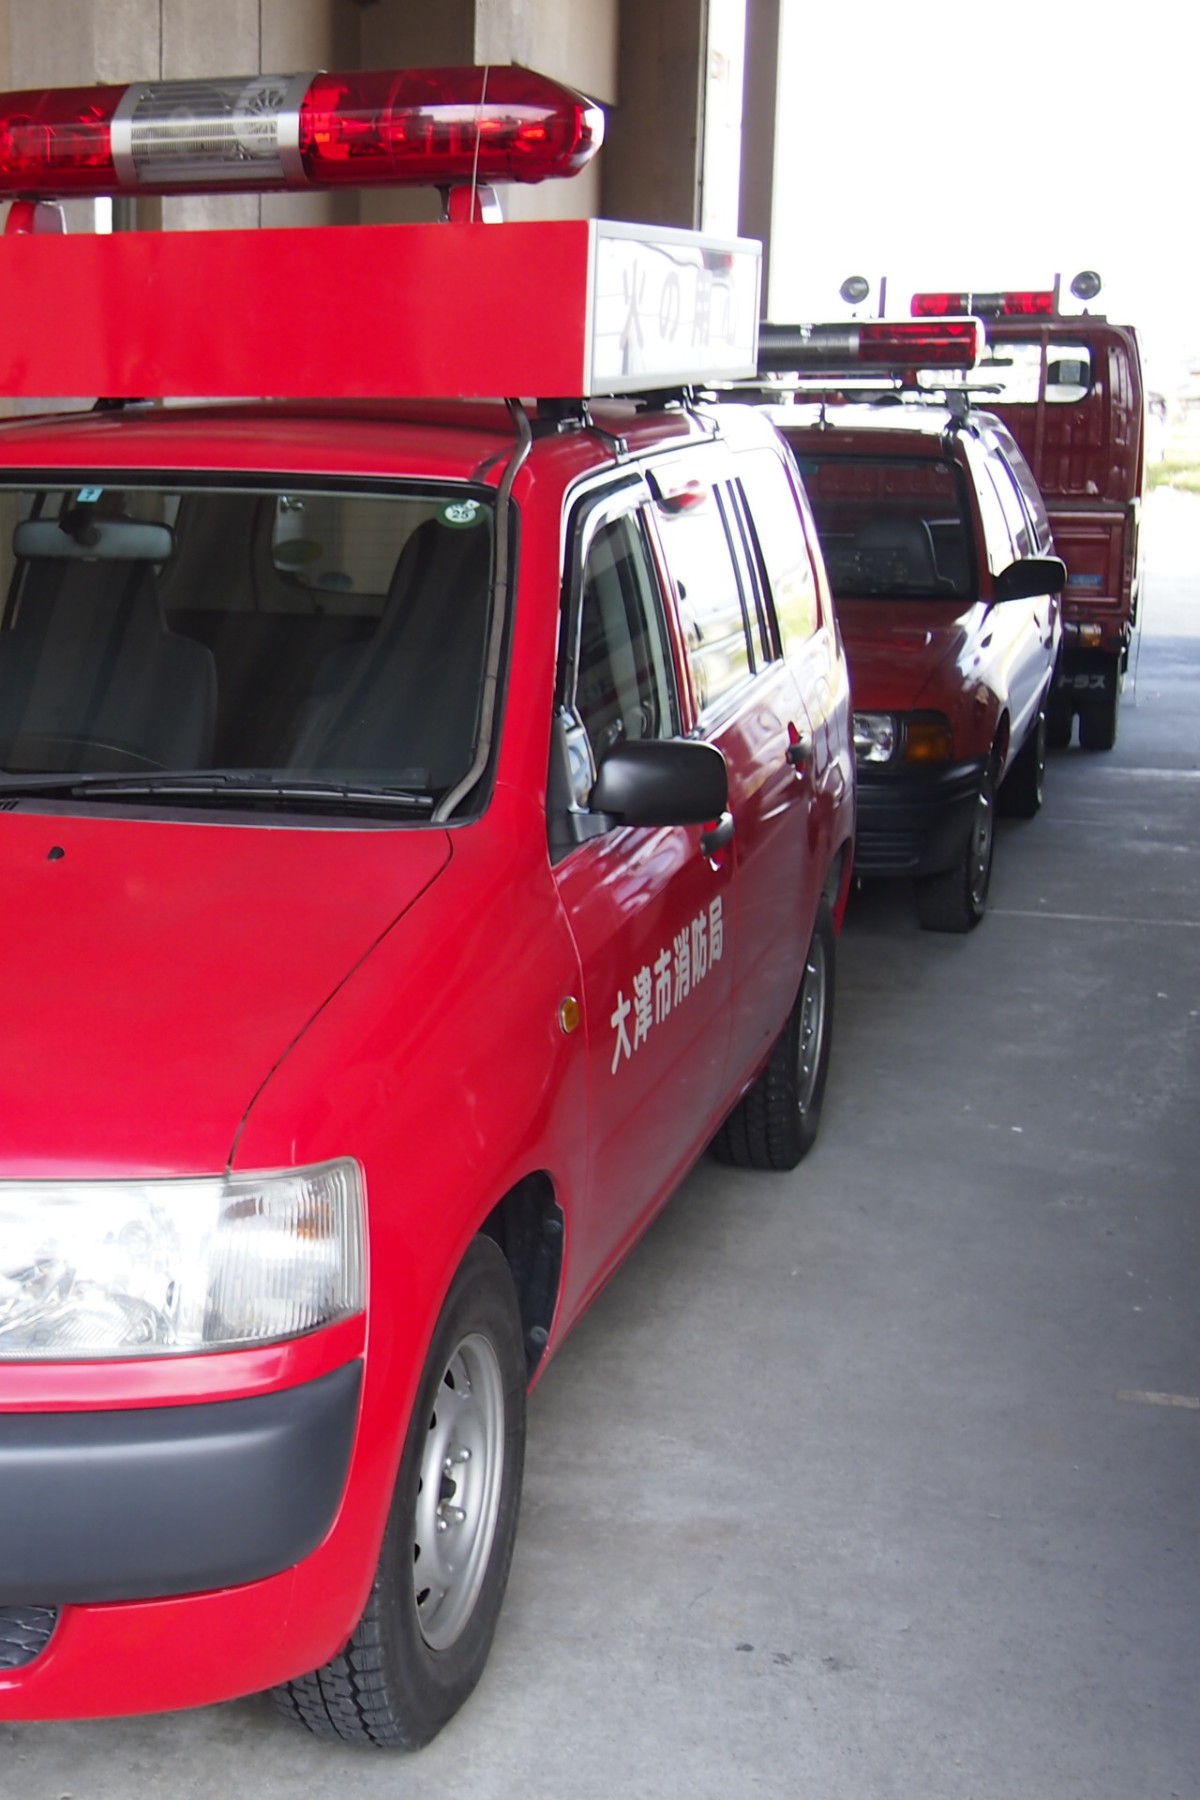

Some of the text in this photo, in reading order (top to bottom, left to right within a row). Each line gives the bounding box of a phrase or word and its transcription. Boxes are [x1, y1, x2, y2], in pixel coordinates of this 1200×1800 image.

[611, 895, 724, 1076] 大津市消防局
